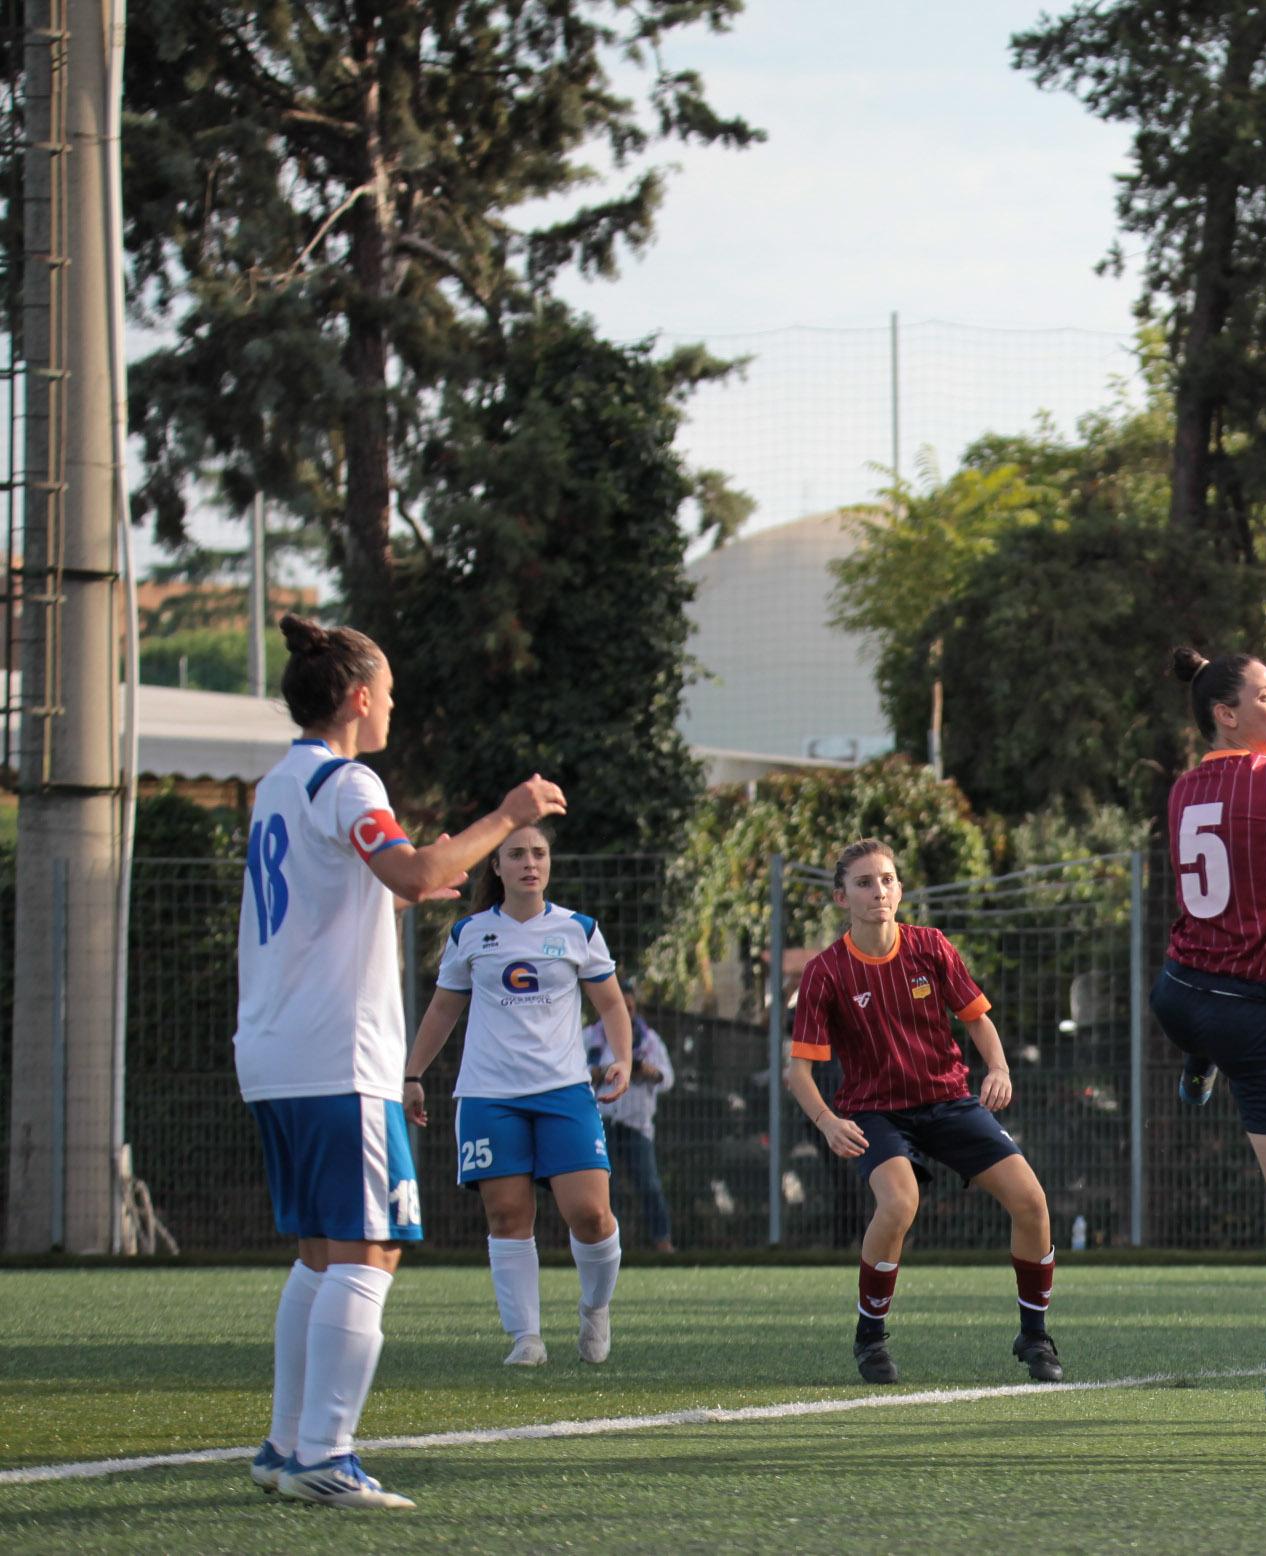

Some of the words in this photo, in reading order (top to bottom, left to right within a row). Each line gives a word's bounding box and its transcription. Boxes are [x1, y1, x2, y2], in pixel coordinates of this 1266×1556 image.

[354, 817, 385, 852] C
[1179, 802, 1231, 919] 5
[246, 813, 289, 945] 18
[461, 1138, 493, 1171] 25
